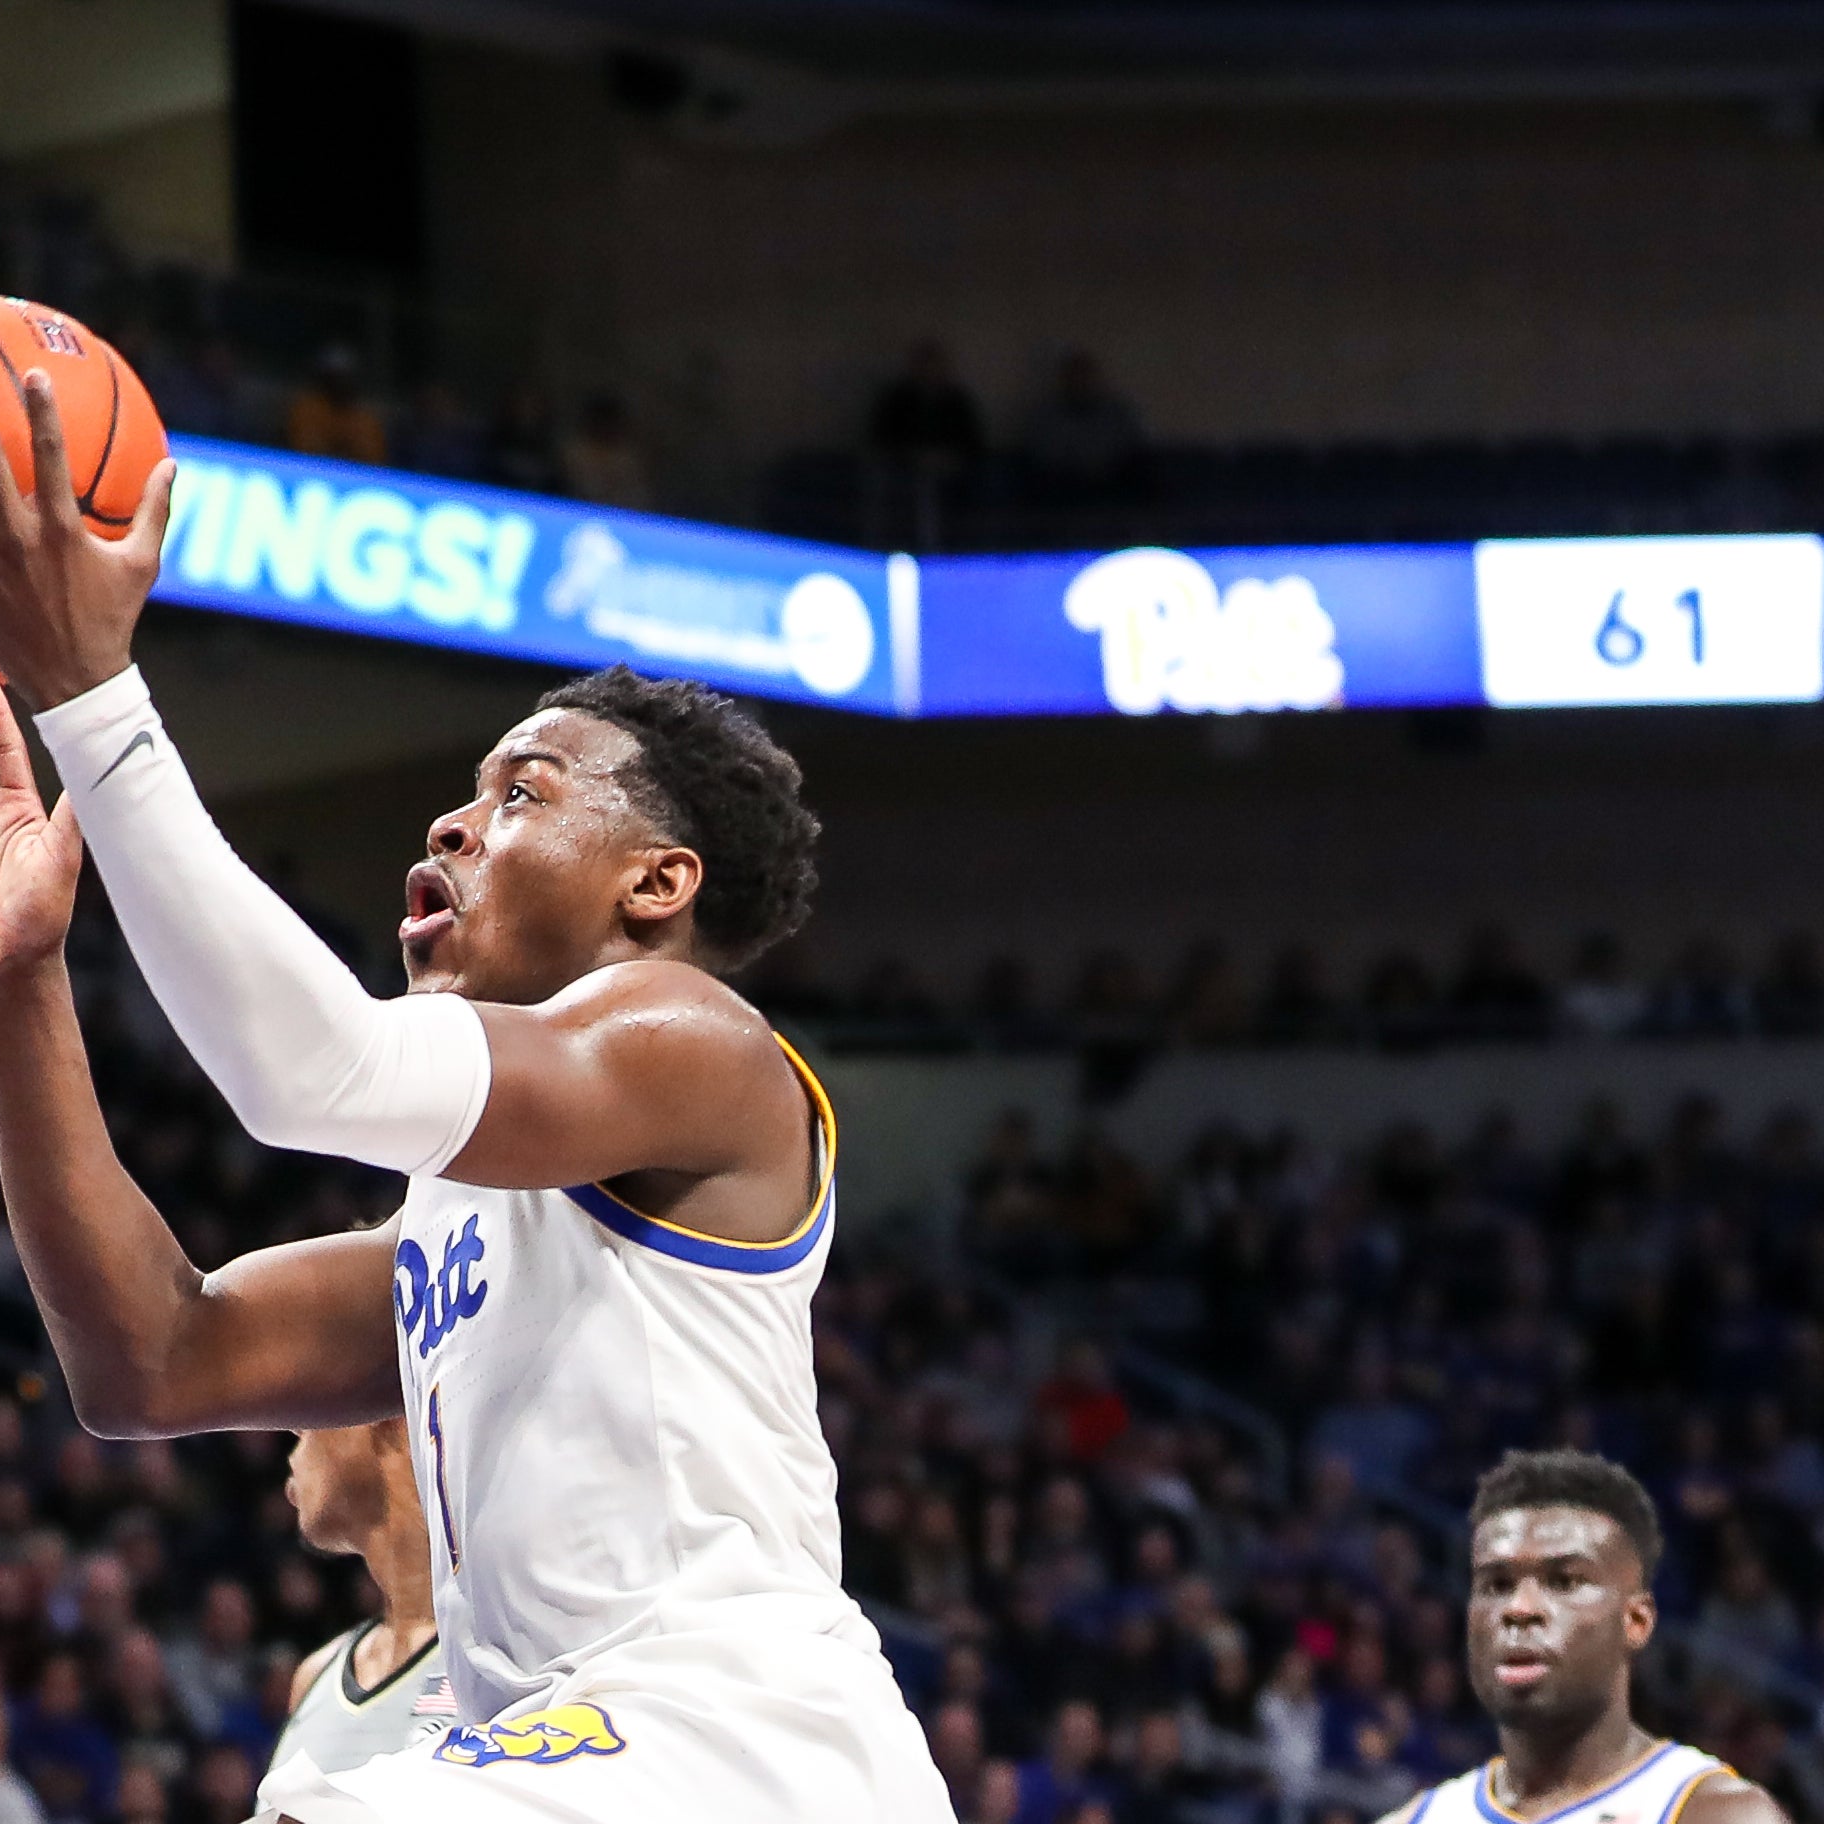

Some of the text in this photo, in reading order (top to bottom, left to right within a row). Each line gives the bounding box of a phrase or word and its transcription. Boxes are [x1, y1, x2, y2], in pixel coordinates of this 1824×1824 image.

[1592, 586, 1706, 668] 61
[393, 1212, 488, 1360] Pitt
[426, 1383, 462, 1576] 1
